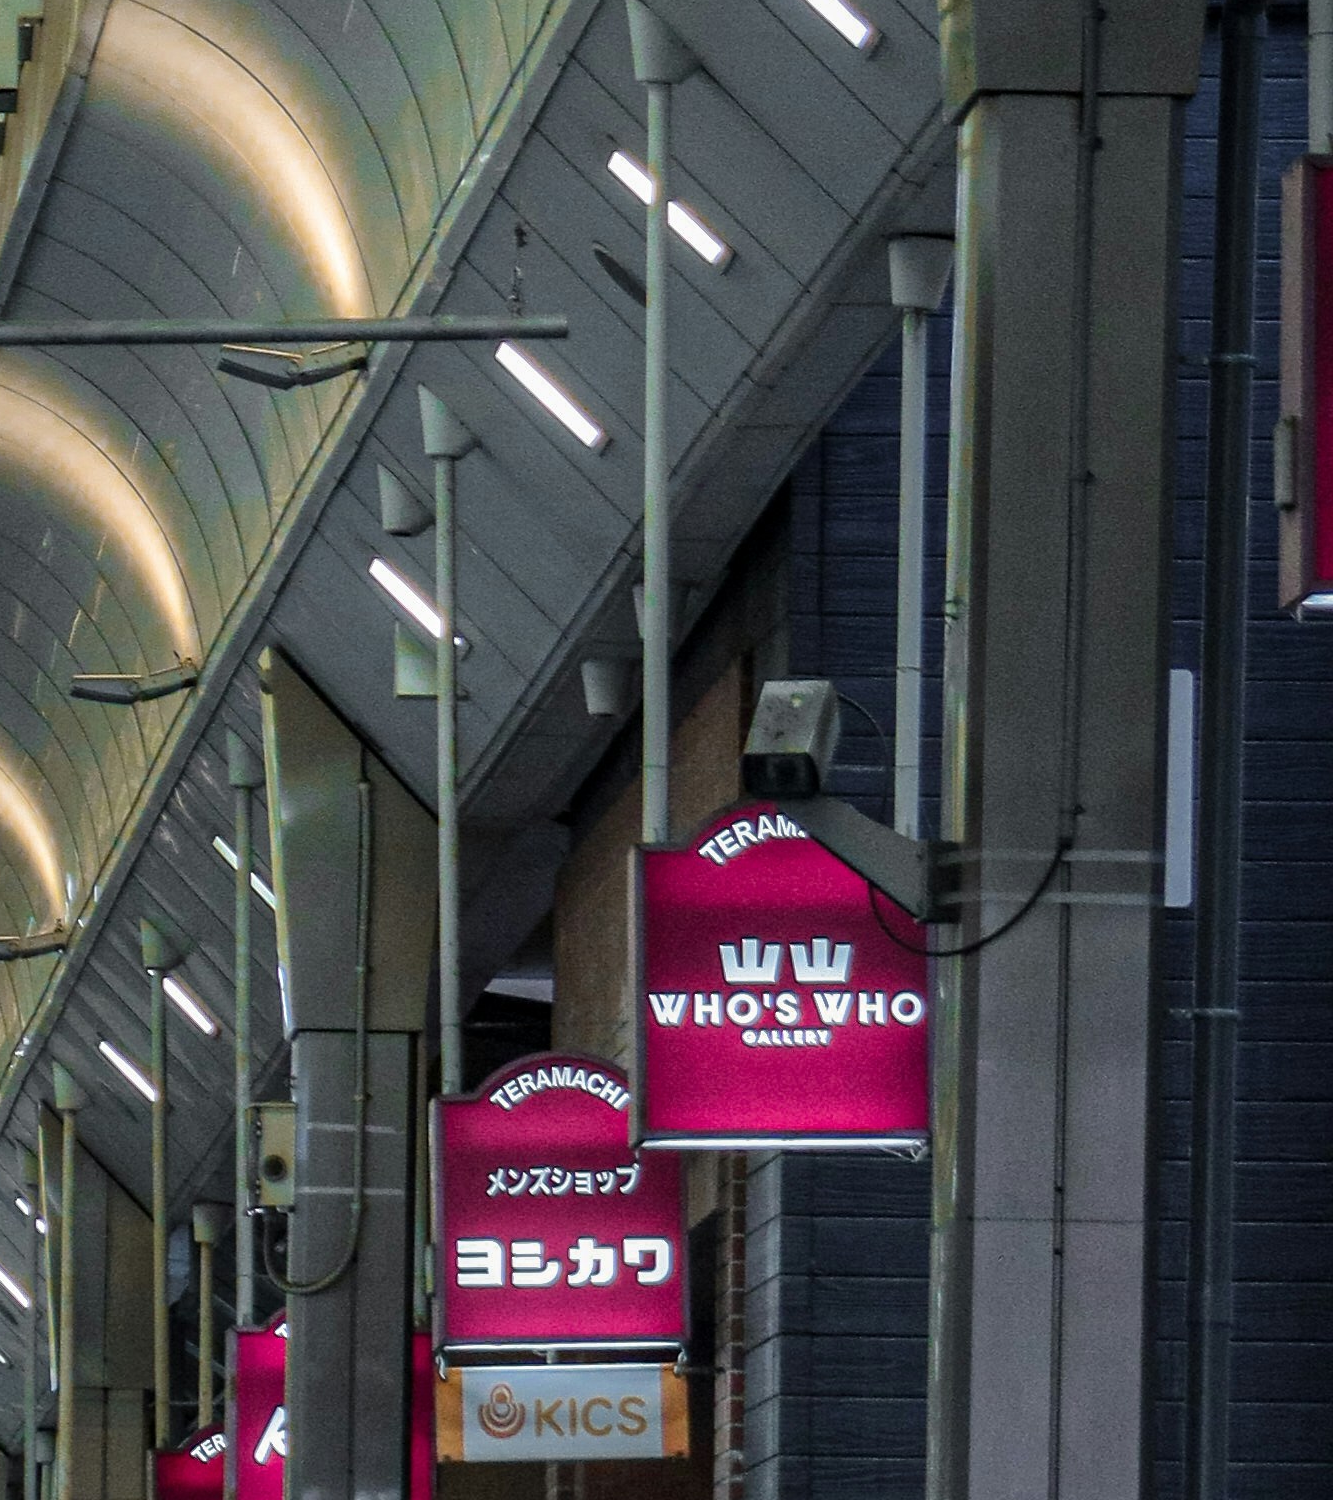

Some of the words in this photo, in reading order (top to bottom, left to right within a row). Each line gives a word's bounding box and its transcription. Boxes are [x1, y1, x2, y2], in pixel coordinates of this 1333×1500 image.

[698, 813, 809, 866] TERAM
[648, 991, 800, 1027] WHO'S
[813, 991, 925, 1027] WHO
[741, 1028, 831, 1046] GALLERY
[490, 1065, 632, 1111] TERAMACHI
[486, 1164, 640, 1197] メンズショップ
[456, 1237, 674, 1288] ヨシカワ
[535, 1396, 648, 1437] KICS
